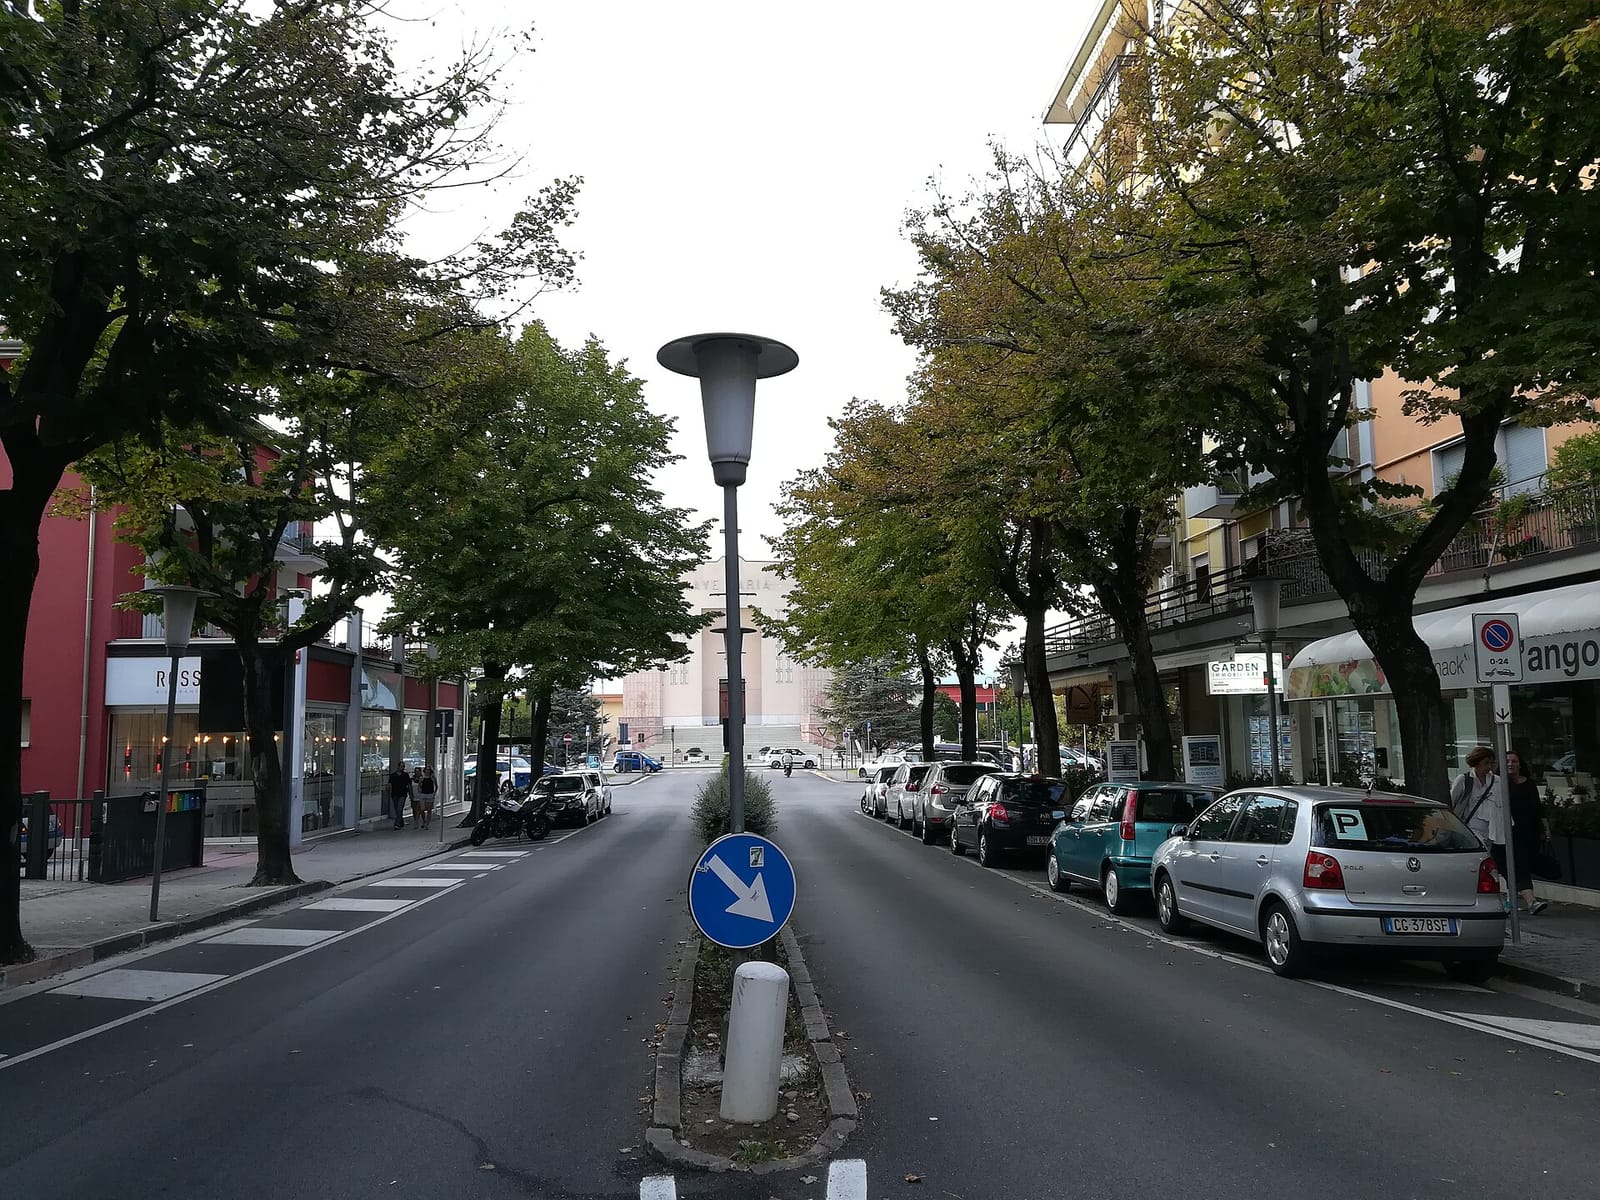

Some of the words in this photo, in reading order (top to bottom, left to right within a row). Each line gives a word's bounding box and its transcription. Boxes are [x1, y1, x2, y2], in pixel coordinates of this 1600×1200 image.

[1211, 663, 1259, 673] GARDEN
[156, 670, 201, 688] RSS
[1334, 814, 1360, 834] P
[1393, 918, 1409, 931] CG
[1411, 919, 1448, 931] 378SF
